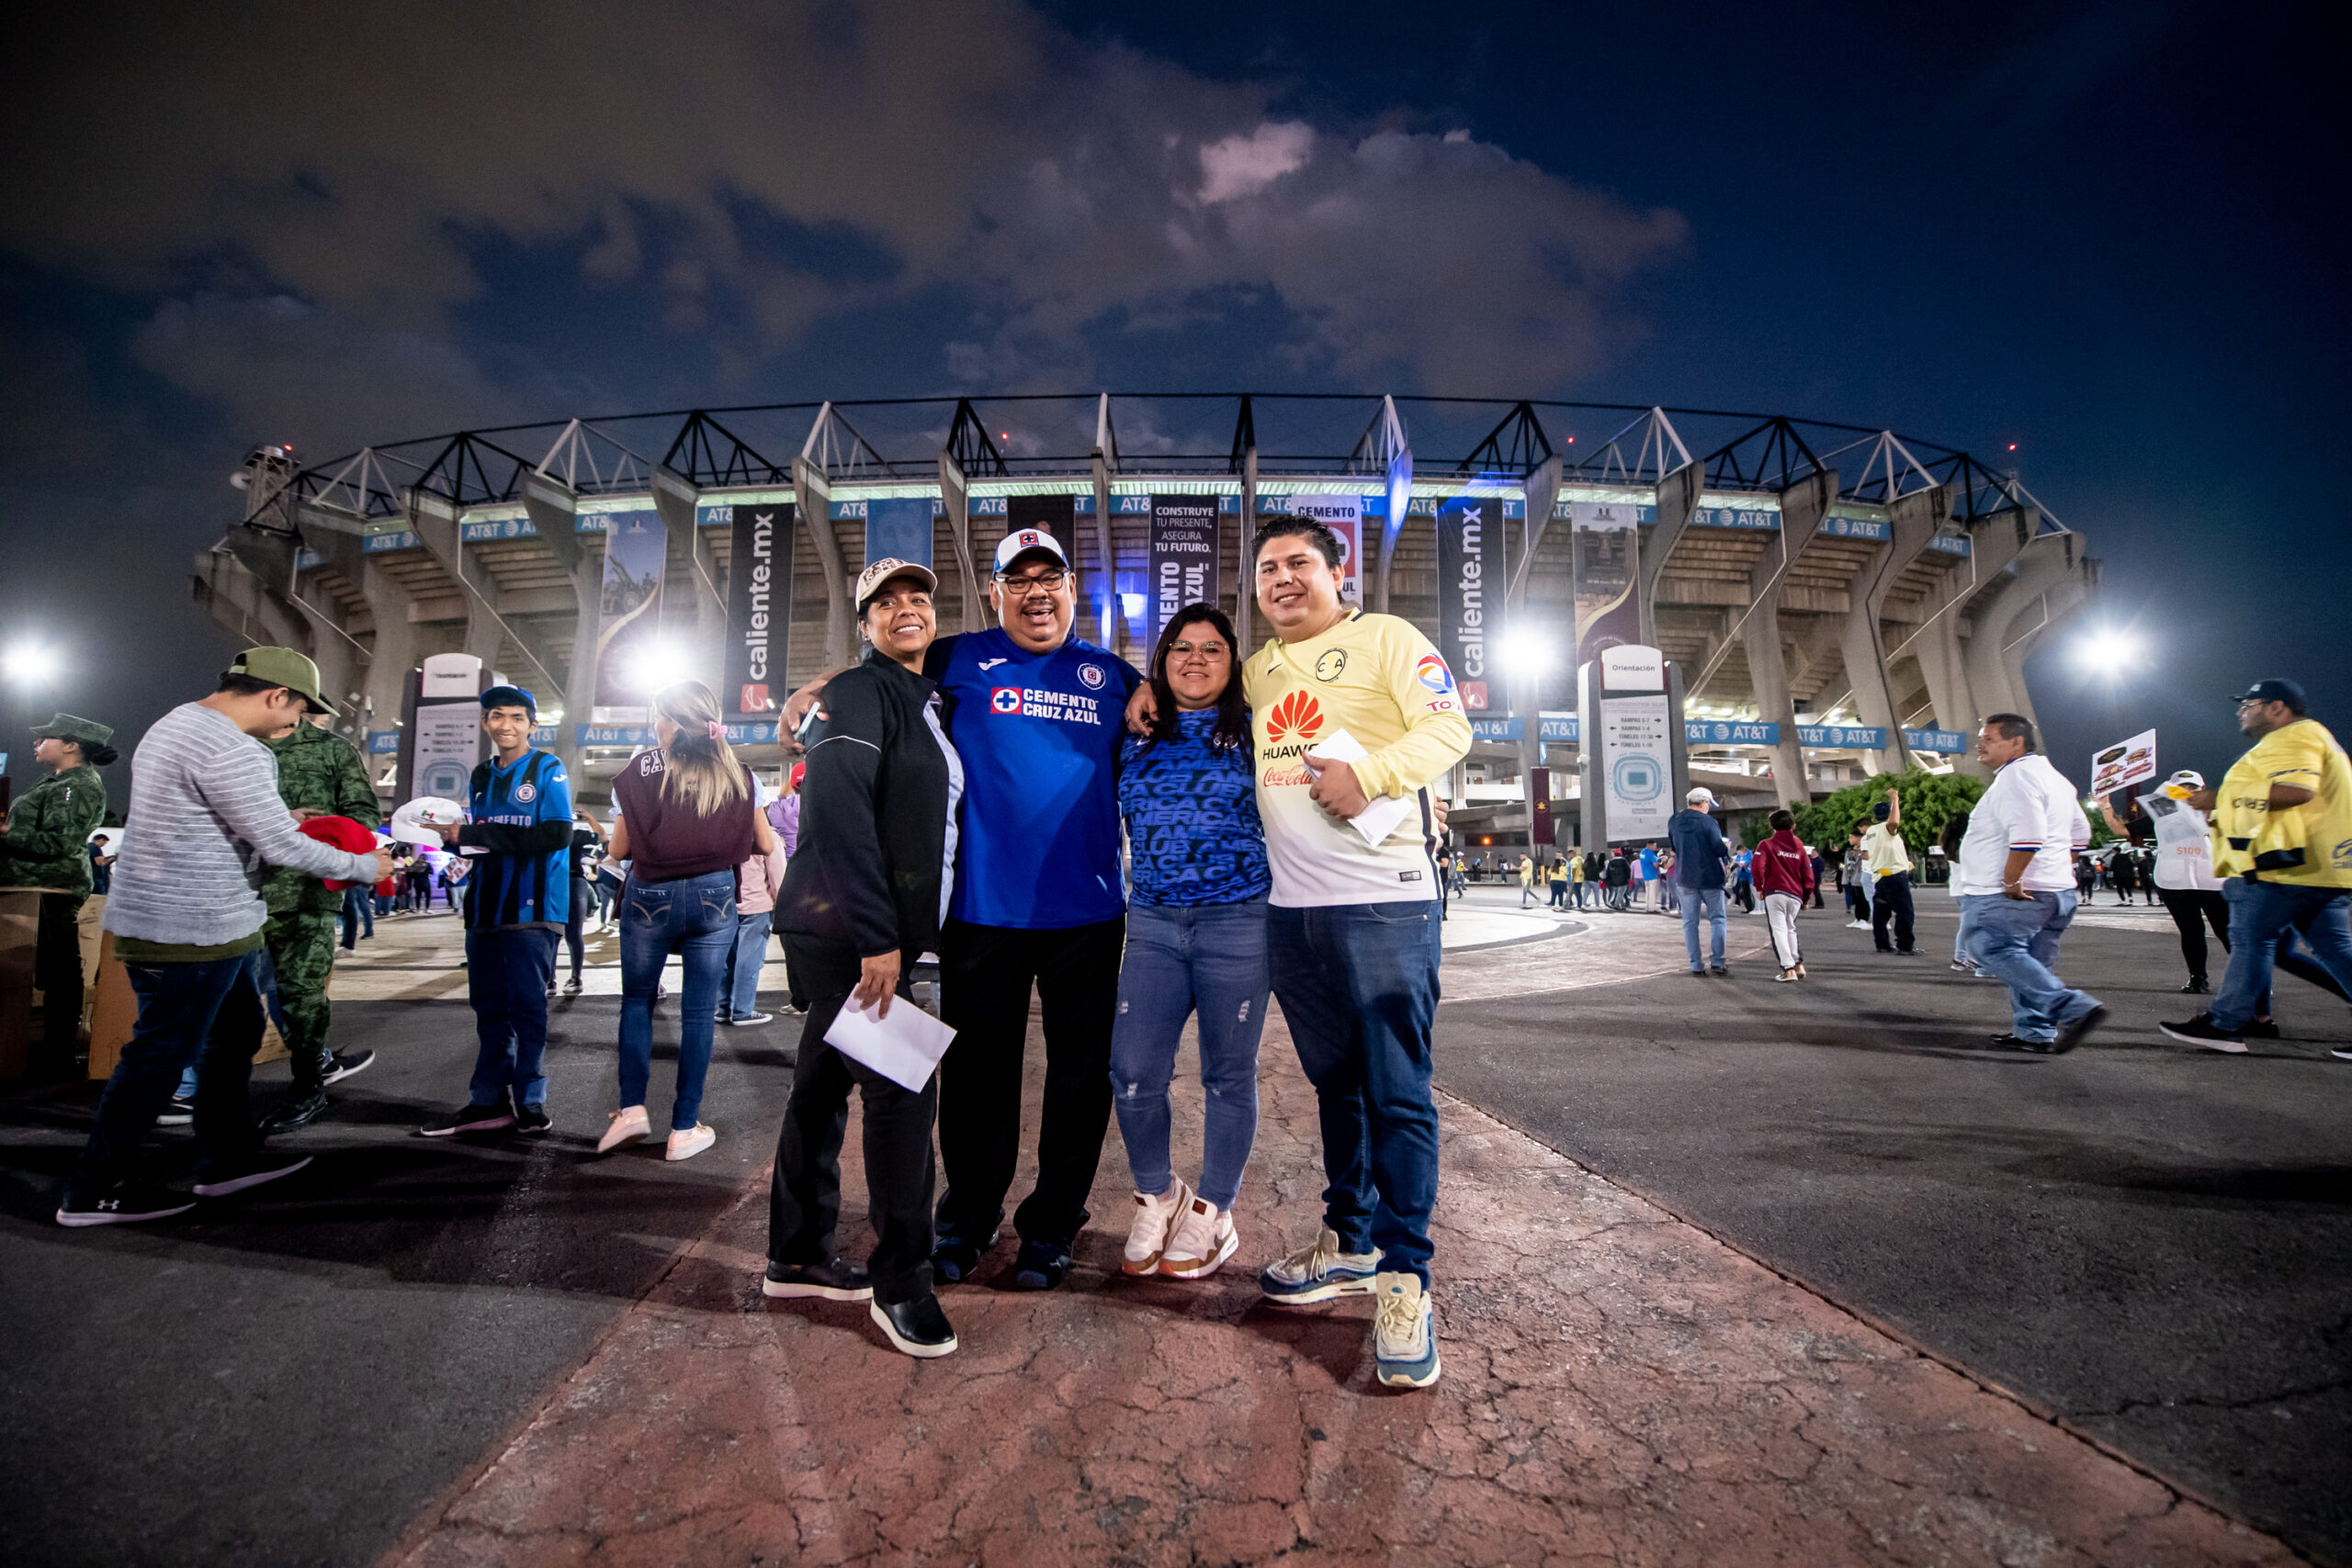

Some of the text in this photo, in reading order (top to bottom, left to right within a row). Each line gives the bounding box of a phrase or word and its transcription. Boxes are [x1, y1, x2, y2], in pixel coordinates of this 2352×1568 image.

[840, 502, 867, 516] AT&
[978, 500, 1007, 513] AT&
[1121, 498, 1149, 512] AT&
[1156, 506, 1214, 516] CONSTRUYE
[1264, 498, 1292, 512] AT&
[1298, 506, 1355, 517] CEMENTO
[1409, 500, 1437, 513] AT&
[707, 507, 732, 522] AT&
[1738, 512, 1772, 526] AT&T
[582, 515, 607, 529] AT&
[1156, 517, 1213, 529] TU PRESENTE,
[468, 523, 501, 538] AT&T
[1161, 531, 1202, 540] ASEGURA
[1850, 522, 1882, 537] AT&T
[371, 534, 398, 549] AT&T
[1155, 542, 1211, 553] TU FUTURO.
[1941, 537, 1964, 551] AT&T
[746, 513, 774, 680] caliente.mx
[1459, 507, 1484, 677] caliente.mx
[1023, 689, 1096, 710] CEMENTO
[1023, 703, 1101, 726] CRUZ AZUL
[585, 728, 618, 740] AT&T
[1473, 721, 1510, 735] AT&T
[1540, 721, 1578, 736] AT&T
[1733, 726, 1770, 739] AT&T
[375, 735, 399, 749] AT&
[1847, 729, 1877, 743] AT&T
[1936, 734, 1959, 747] AT&T
[1263, 744, 1318, 761] HUAW
